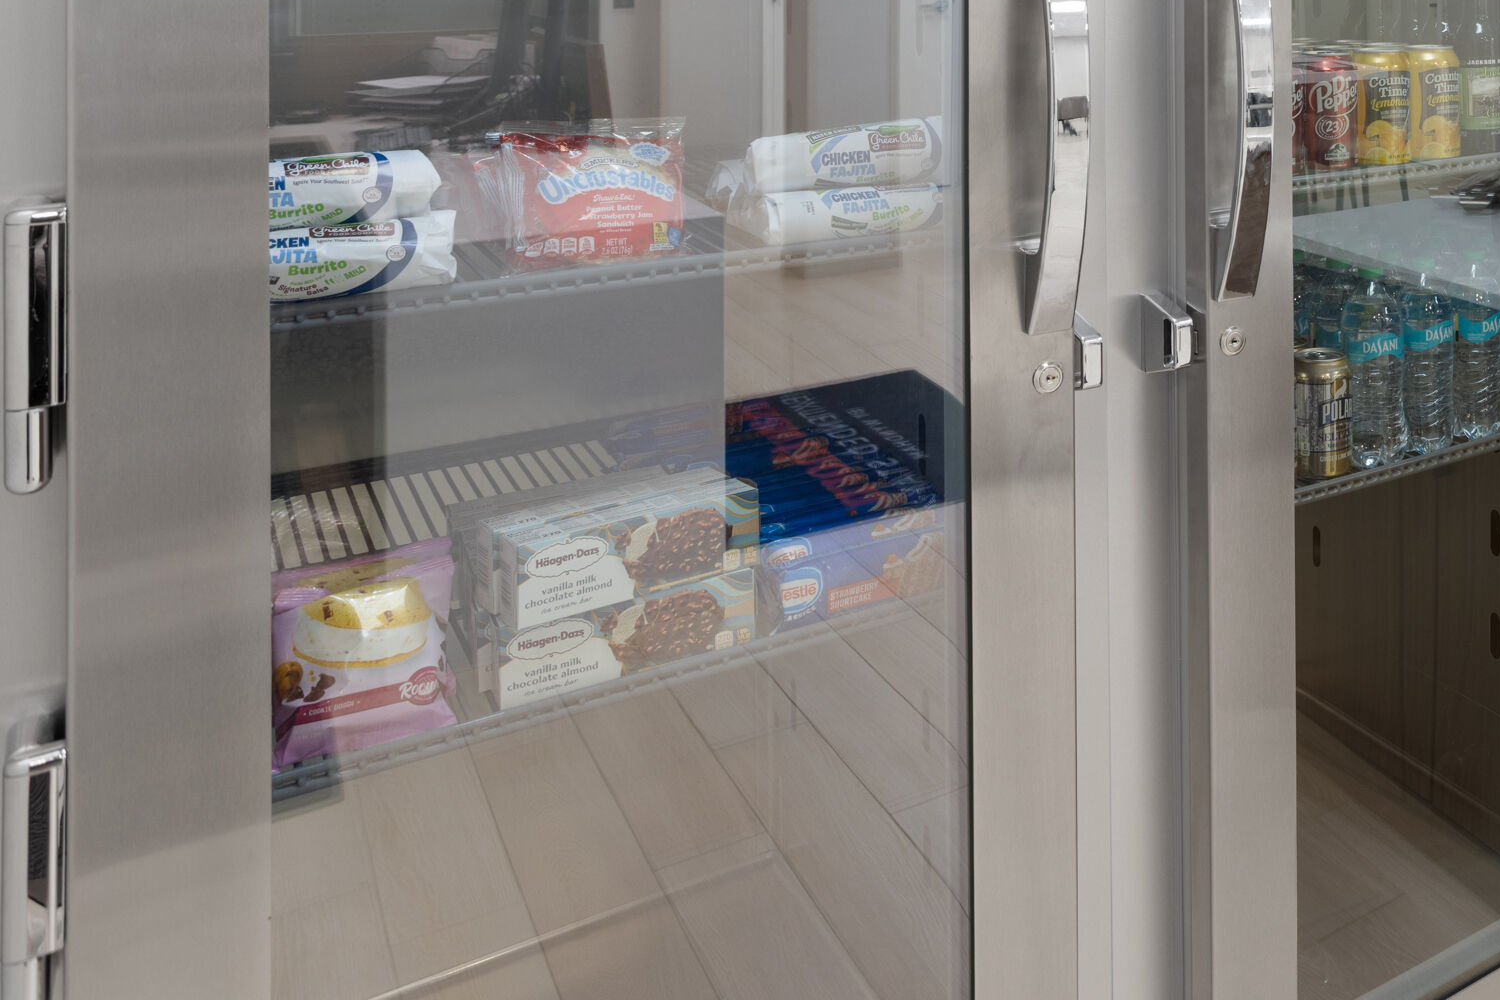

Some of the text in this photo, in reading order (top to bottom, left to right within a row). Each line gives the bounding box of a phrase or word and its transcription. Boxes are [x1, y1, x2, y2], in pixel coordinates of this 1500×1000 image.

[1332, 75, 1352, 94] Dr
[1379, 86, 1407, 98] Time
[1326, 120, 1339, 133] 23
[871, 132, 923, 150] Green Chile
[822, 150, 871, 166] CHICKEN
[287, 159, 369, 176] Green Chile
[830, 163, 876, 178] FAJITA
[538, 168, 675, 203] Uncrustables
[831, 191, 880, 203] CHICKEN
[269, 203, 324, 219] Burrito
[842, 199, 890, 214] FAJITA
[872, 204, 910, 221] Burrito
[588, 212, 635, 221] Strawberry
[312, 224, 393, 237] Green Chile
[288, 260, 347, 276] Burrito
[343, 265, 367, 280] MILD
[278, 284, 317, 294] Signature
[306, 286, 329, 296] Salsa
[1363, 337, 1398, 355] DASANI
[535, 545, 600, 569] Häagen-Dazs
[541, 573, 597, 596] vanilla milk
[830, 582, 879, 601] STRAWBERRY
[524, 579, 613, 609] chocolate almond
[830, 591, 873, 610] SHORTCAKE
[517, 627, 585, 651] Häagen-Dazs
[524, 656, 582, 678] vanilla milk
[507, 660, 599, 693] chocolate almond
